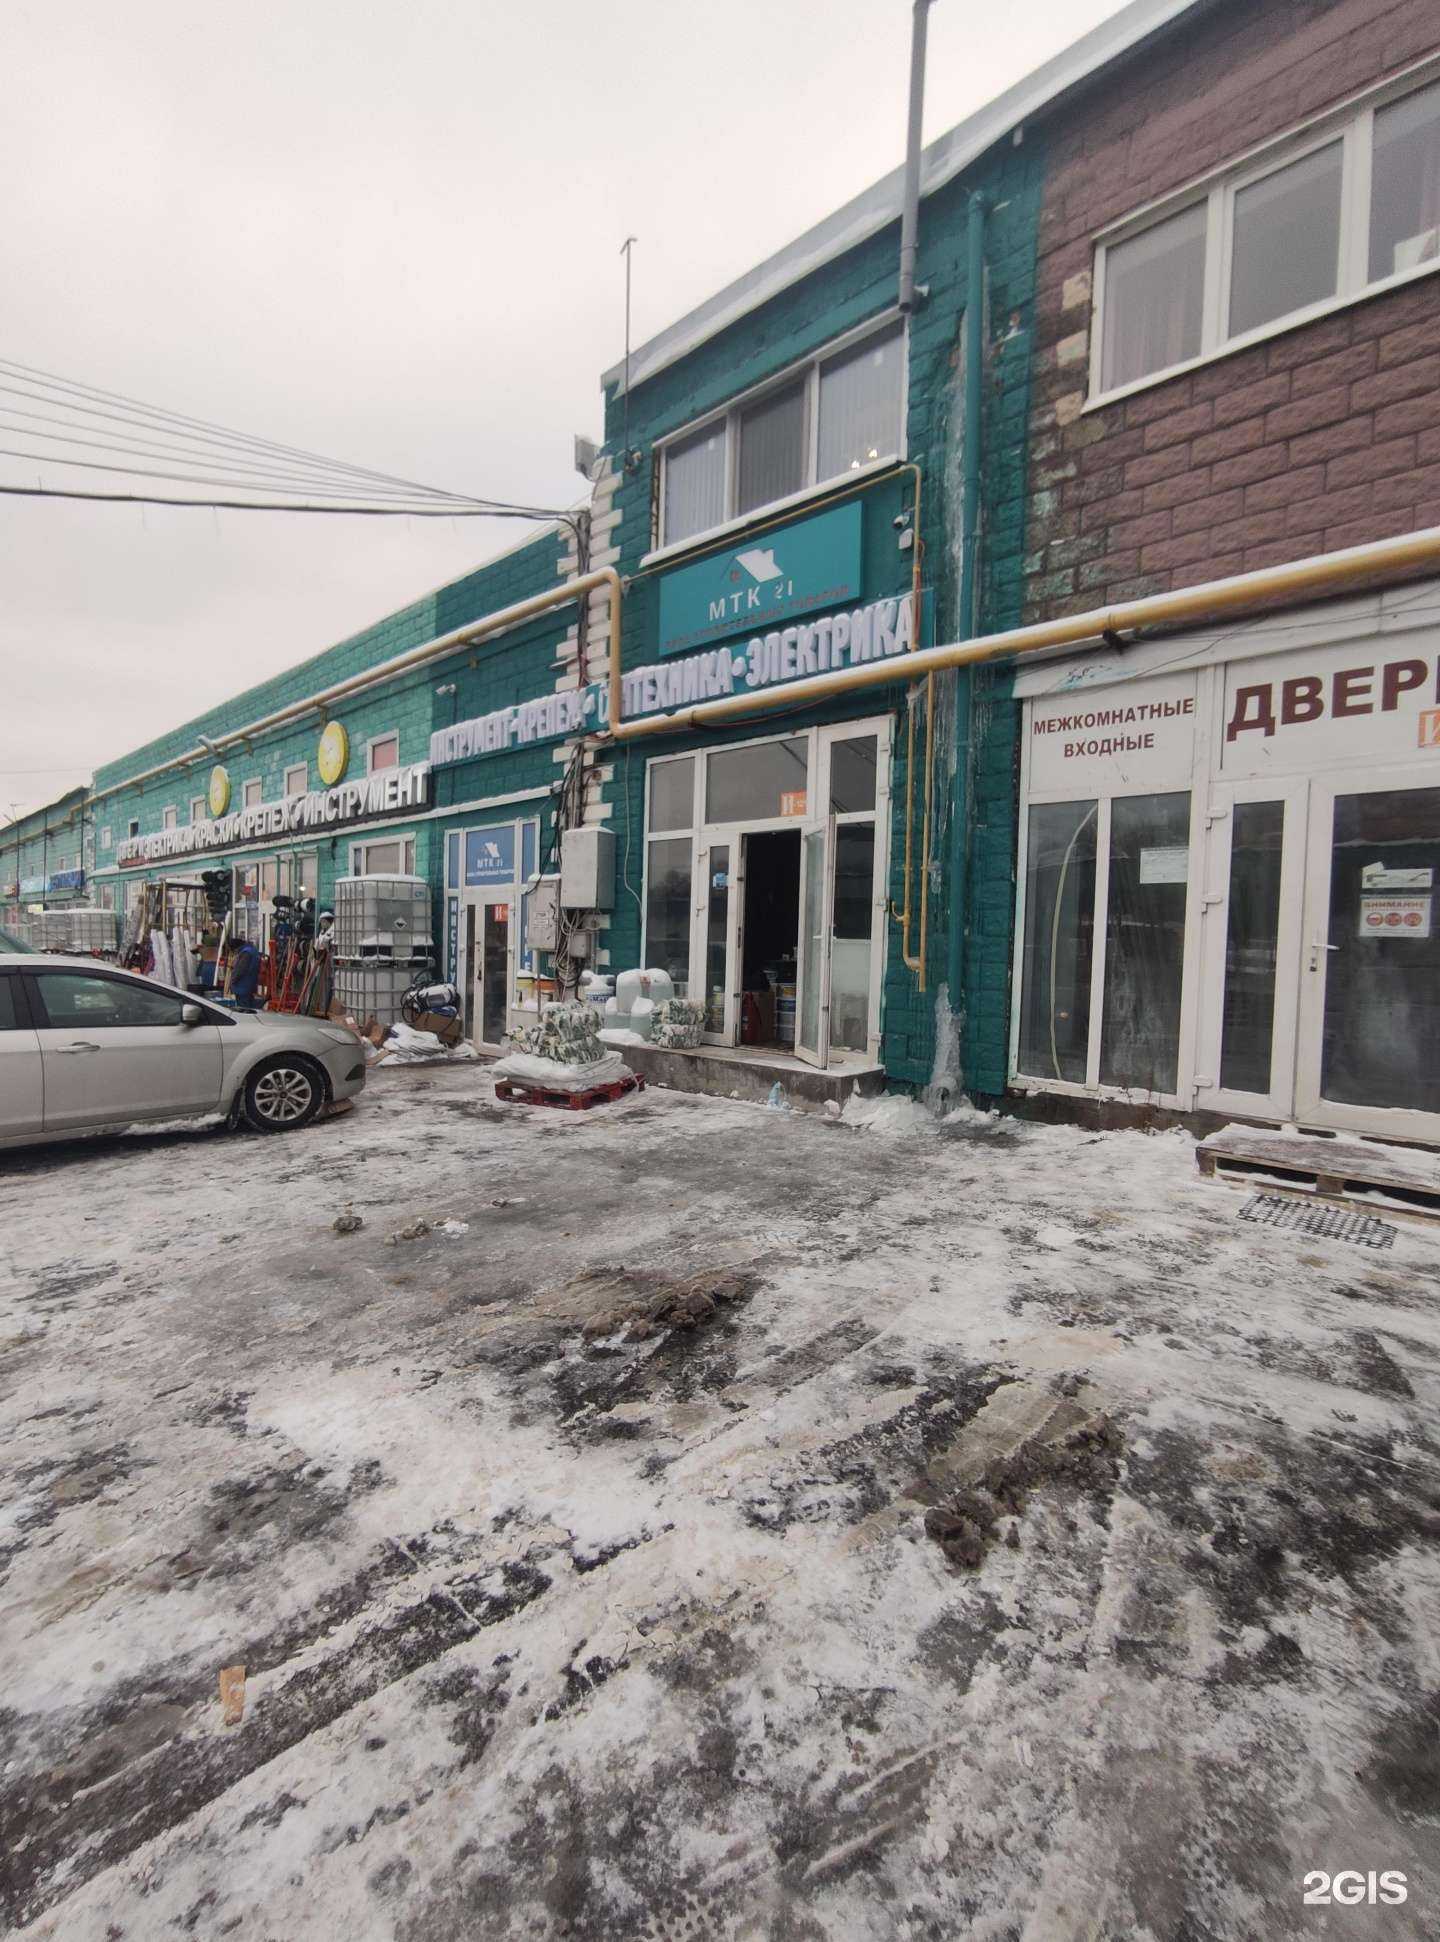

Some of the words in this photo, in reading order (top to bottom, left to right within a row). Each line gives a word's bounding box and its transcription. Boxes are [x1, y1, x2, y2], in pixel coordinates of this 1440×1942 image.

[708, 586, 761, 622] МТК
[745, 595, 913, 688] ЭЛЕКТРИКА
[1033, 698, 1194, 735] МЕЖКОМНАТНЫЕ
[1226, 658, 1440, 742] ДВЕР
[1064, 733, 1155, 758] ВХОДНЫЕ
[302, 764, 430, 826] ИНСТРУМЕНТ
